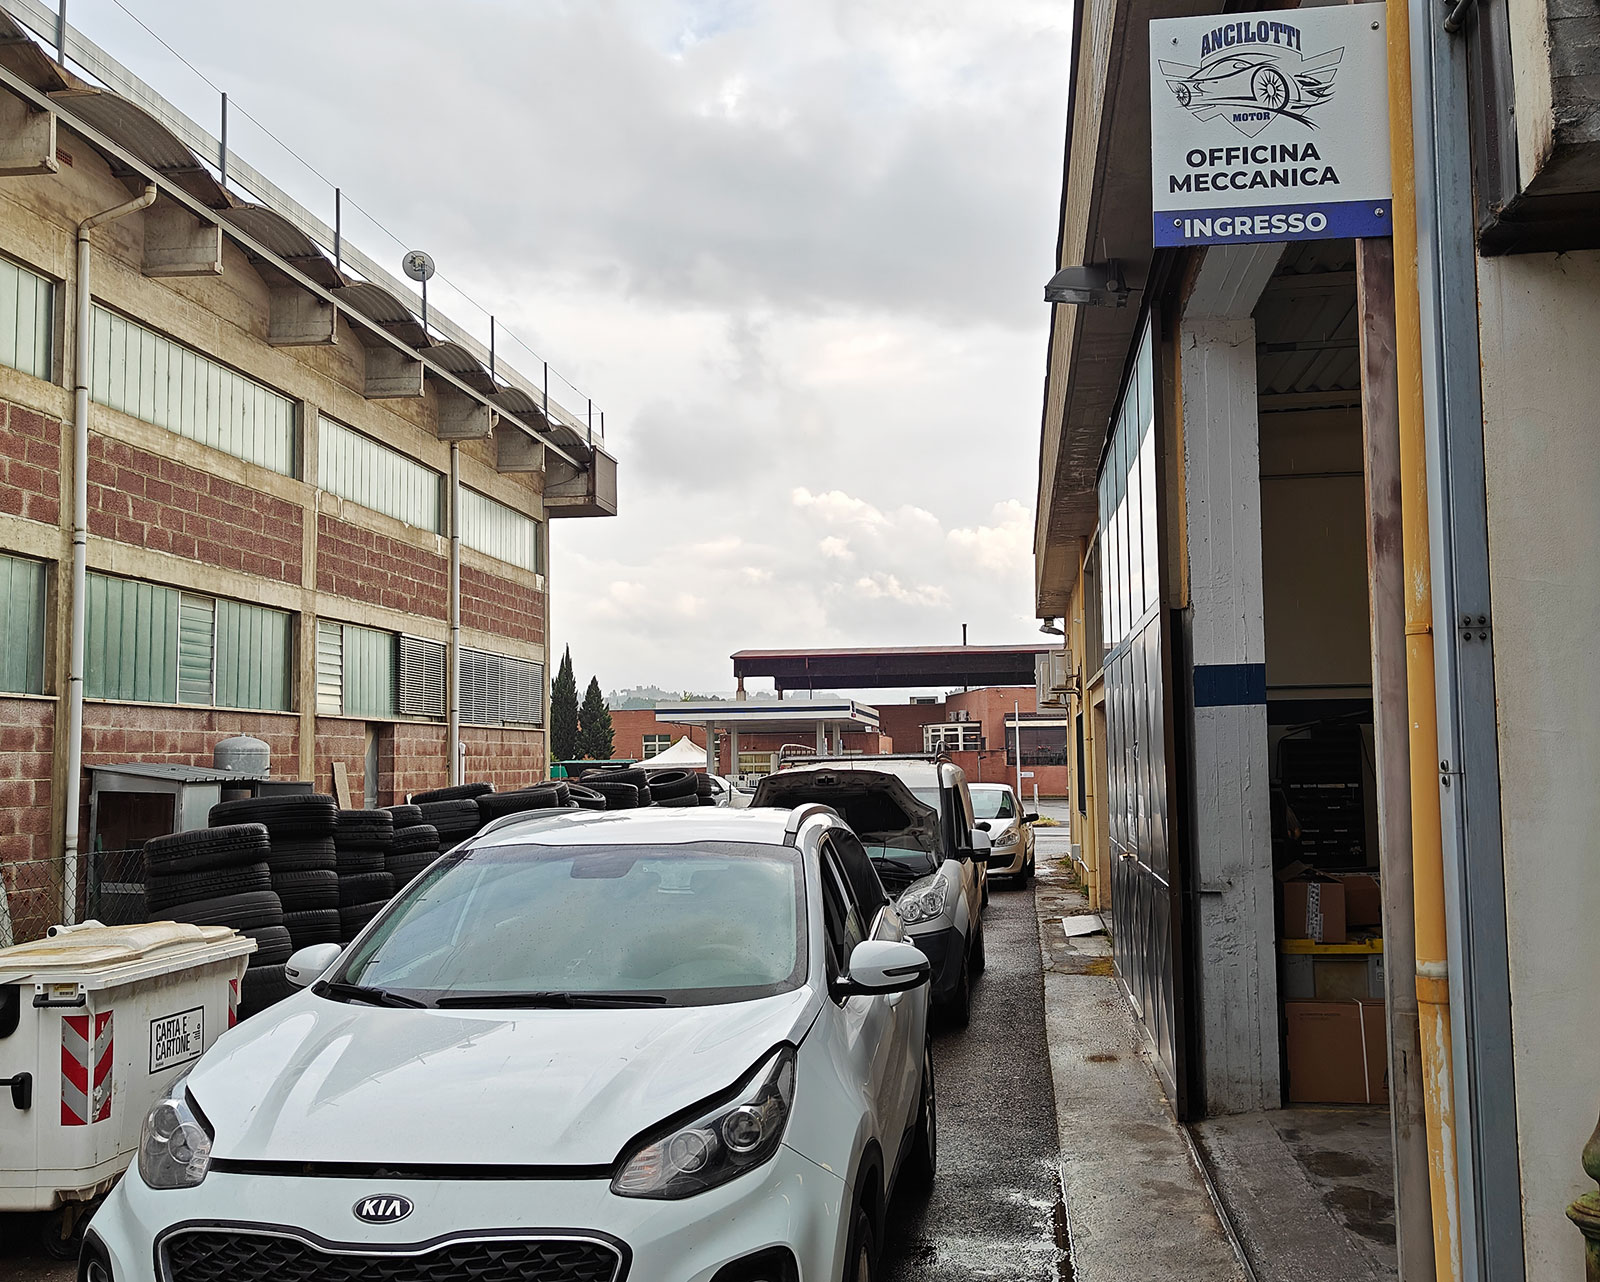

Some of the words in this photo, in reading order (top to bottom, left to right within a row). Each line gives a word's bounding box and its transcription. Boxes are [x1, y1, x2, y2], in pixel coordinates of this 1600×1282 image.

[1200, 20, 1302, 58] ANCILOTTI
[1232, 112, 1271, 122] MOTOR
[1186, 142, 1321, 168] OFFICINA
[1169, 166, 1340, 193] MECCANICA
[1184, 212, 1328, 238] INGRESSO
[156, 1018, 181, 1042] CARTA
[183, 1016, 187, 1034] E
[156, 1033, 190, 1061] CARTONE
[361, 1199, 401, 1216] KIA
